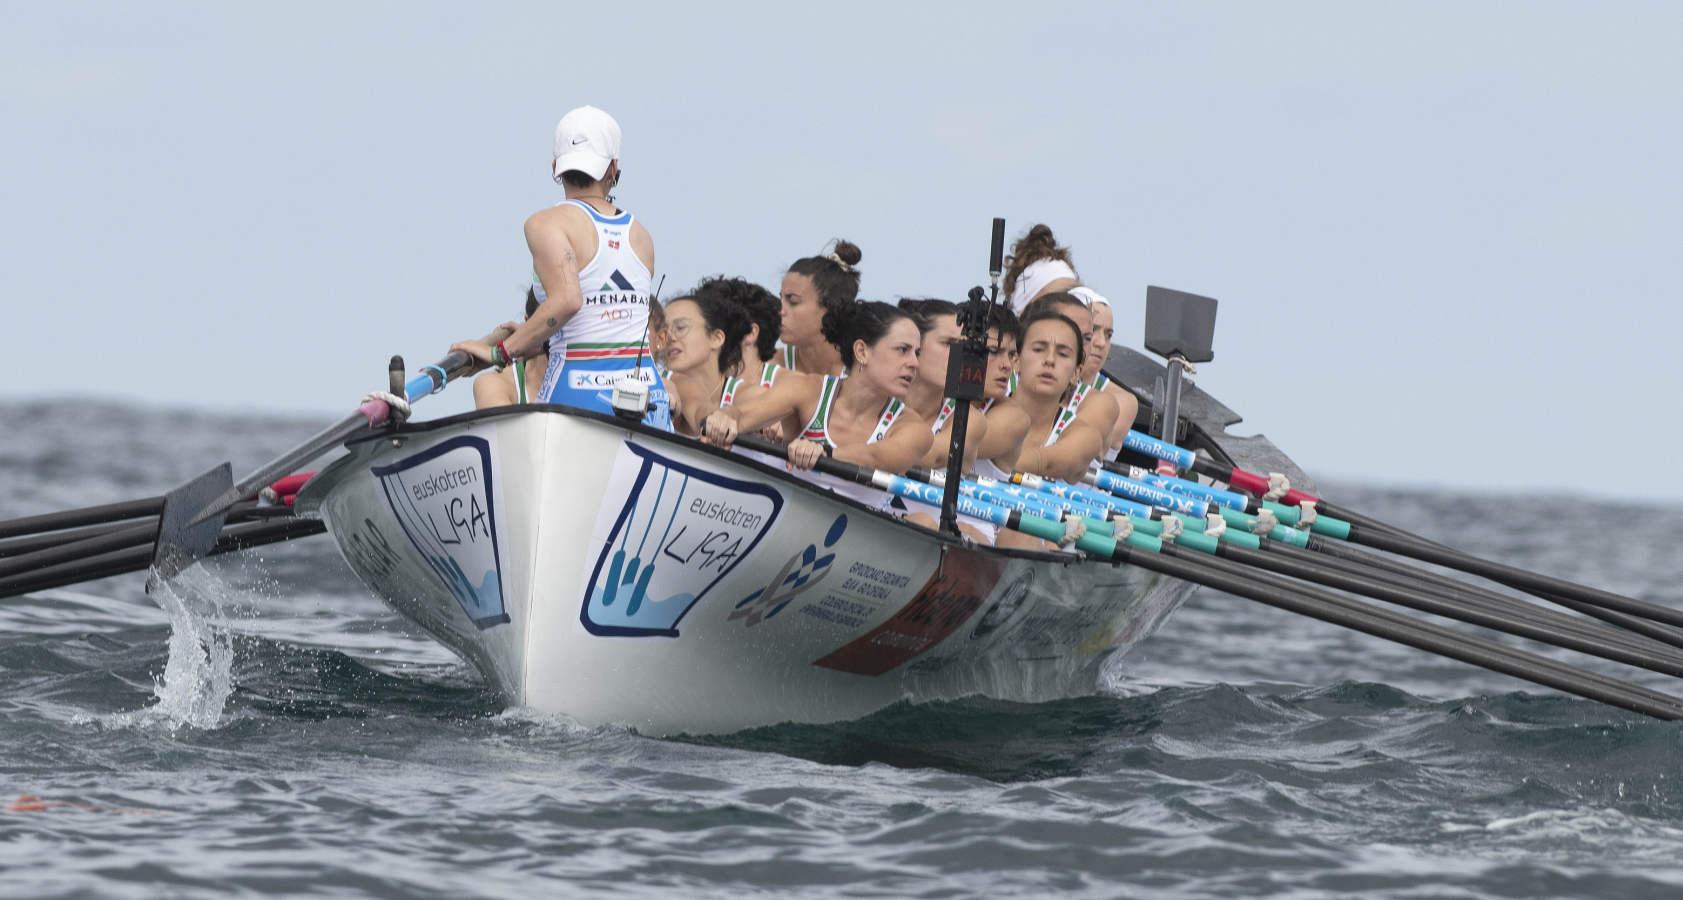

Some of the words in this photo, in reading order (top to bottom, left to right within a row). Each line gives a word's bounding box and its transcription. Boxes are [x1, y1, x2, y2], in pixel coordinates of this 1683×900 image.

[594, 371, 652, 386] Caink
[1127, 434, 1181, 464] aixaBank
[412, 465, 477, 500] euskotren
[1109, 476, 1174, 508] CaixaBank
[427, 493, 489, 544] LIGA
[689, 497, 762, 530] euskotren
[924, 487, 993, 520] CaBank
[663, 525, 743, 573] LIGA
